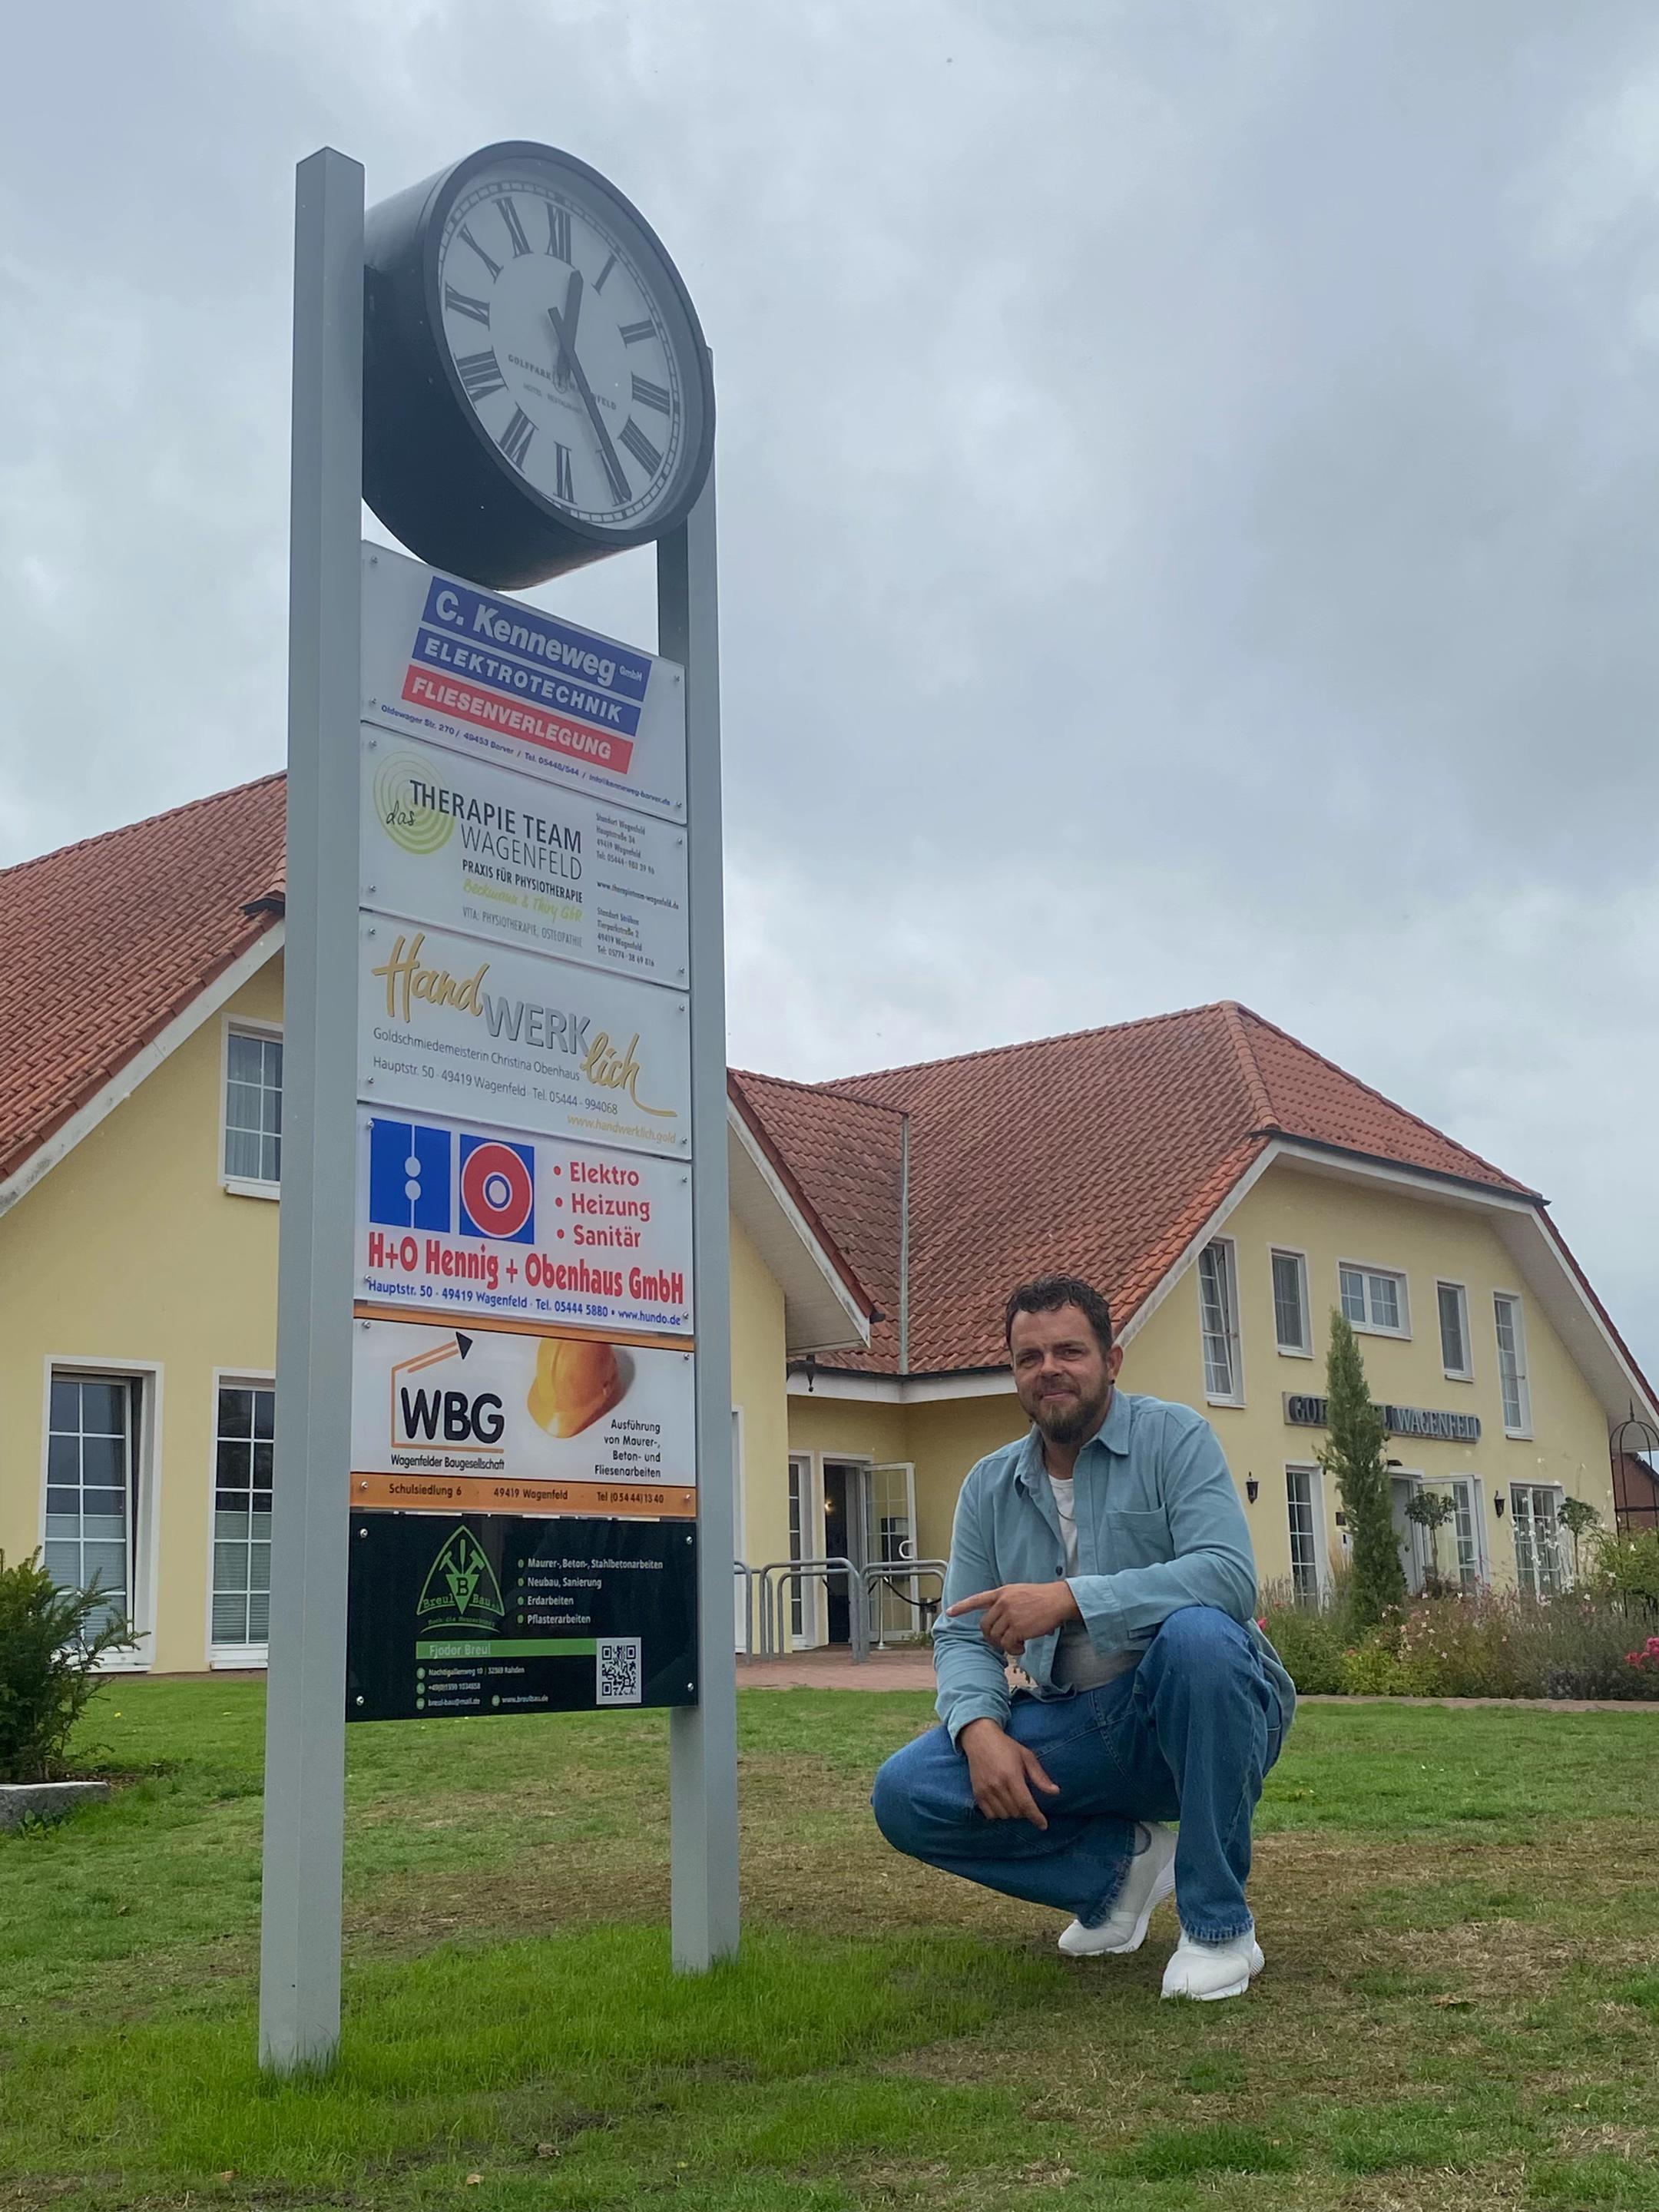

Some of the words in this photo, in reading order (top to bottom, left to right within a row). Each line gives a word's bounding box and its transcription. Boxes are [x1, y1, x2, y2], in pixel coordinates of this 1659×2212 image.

[492, 197, 534, 259] XI
[543, 200, 576, 269] XII
[457, 224, 504, 284] X
[591, 250, 618, 296] I
[444, 281, 490, 331] IX
[617, 315, 657, 349] II
[453, 346, 508, 409] VIII
[631, 372, 671, 415] III
[495, 402, 539, 475] VII
[553, 441, 578, 505] VI
[436, 590, 464, 625] C.
[473, 604, 616, 686] Kenneweg
[425, 637, 622, 723] ELEKTROTECHNIK
[412, 676, 611, 760] FLIESENVERLEGUNG
[439, 724, 455, 735] 270
[386, 800, 416, 826] das
[410, 780, 516, 834] THERAPIE
[523, 814, 581, 854] TEAM
[461, 824, 581, 879] WAGENFELD
[462, 859, 493, 879] PRAXIS
[496, 867, 512, 883] FÜR
[515, 874, 582, 903] PHYSIOTHERAPIE
[373, 1027, 488, 1061] Goldschmiedemeisterin
[492, 1052, 531, 1071] Christina
[534, 1061, 579, 1081] Obenhaus
[373, 1055, 418, 1075] Hauptstr.
[422, 1065, 434, 1078] 50
[442, 1070, 472, 1086] 49419
[474, 1076, 526, 1097] Wagenfeld
[533, 1088, 548, 1101] Tel.
[549, 1091, 578, 1106] 05444
[585, 1098, 618, 1115] 994068
[568, 1115, 676, 1144] www.handwerklich.gold
[570, 1161, 639, 1186] Elektro
[572, 1193, 650, 1222] Heizung
[574, 1224, 641, 1247] Sanitär
[369, 1232, 418, 1271] H+O
[426, 1240, 498, 1290] Hennig
[506, 1259, 518, 1283] +
[525, 1253, 622, 1296] Obenhaus
[630, 1267, 683, 1304] GmbH
[369, 1280, 416, 1295] Hauptstr.
[421, 1286, 432, 1296] 50
[442, 1288, 472, 1301] 49419
[476, 1291, 527, 1307] Wagenfeld
[536, 1299, 551, 1310] Tel.
[555, 1301, 582, 1313] 05444
[586, 1306, 608, 1316] 5880
[618, 1310, 680, 1325] www.hundo.de
[401, 1387, 504, 1444] WBG
[611, 1419, 661, 1435] Ausführung
[1394, 1407, 1481, 1439] WAGENFELD
[613, 1450, 641, 1461] Beton-
[644, 1452, 661, 1462] und
[623, 1435, 661, 1449] Maurer-,
[391, 1454, 442, 1469] Wagenfelder
[445, 1456, 505, 1472] Baugesellschaft
[594, 1465, 661, 1478] Fliesenarbeiten
[389, 1483, 452, 1498] Schulsiedlung
[456, 1487, 462, 1496] 6
[493, 1487, 519, 1498] 49419
[523, 1488, 568, 1502] Wagenfeld
[597, 1492, 608, 1501] Tel
[528, 1558, 562, 1569] Maurer-,
[591, 1559, 664, 1570] Stahlbetonarbeiten
[456, 1578, 469, 1596] B
[528, 1577, 561, 1588] Neubau,
[562, 1578, 602, 1589] Sanierung
[528, 1595, 574, 1605] Erdarbeiten
[422, 1593, 455, 1608] Breul
[528, 1614, 591, 1624] Pflasterarbeiten
[430, 1644, 461, 1659] Fjodor
[465, 1643, 491, 1655] Breul
